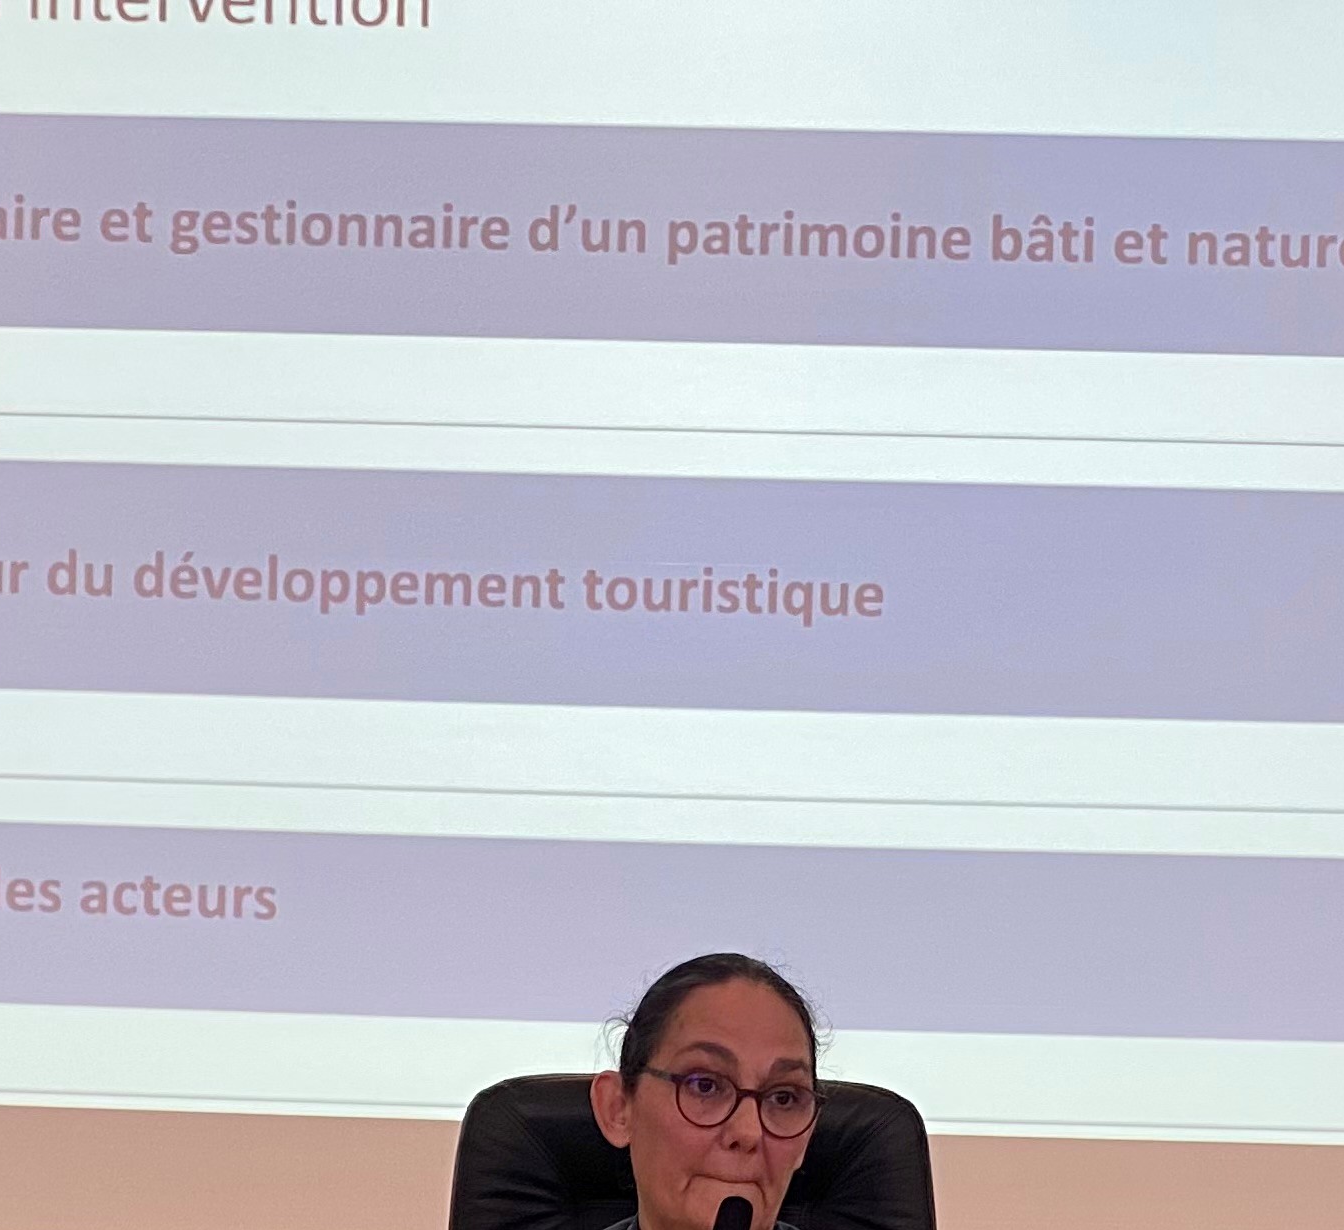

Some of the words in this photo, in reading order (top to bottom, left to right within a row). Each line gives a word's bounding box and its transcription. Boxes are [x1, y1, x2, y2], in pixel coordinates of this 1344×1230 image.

[99, 201, 154, 244] et
[168, 199, 511, 255] gestionnaire
[667, 209, 972, 266] patrimoine
[991, 213, 1095, 264] bâti
[1113, 223, 1170, 266] et
[46, 547, 114, 598] du
[133, 550, 566, 617] développement
[582, 566, 884, 629] touristique
[79, 874, 277, 921] acteurs
